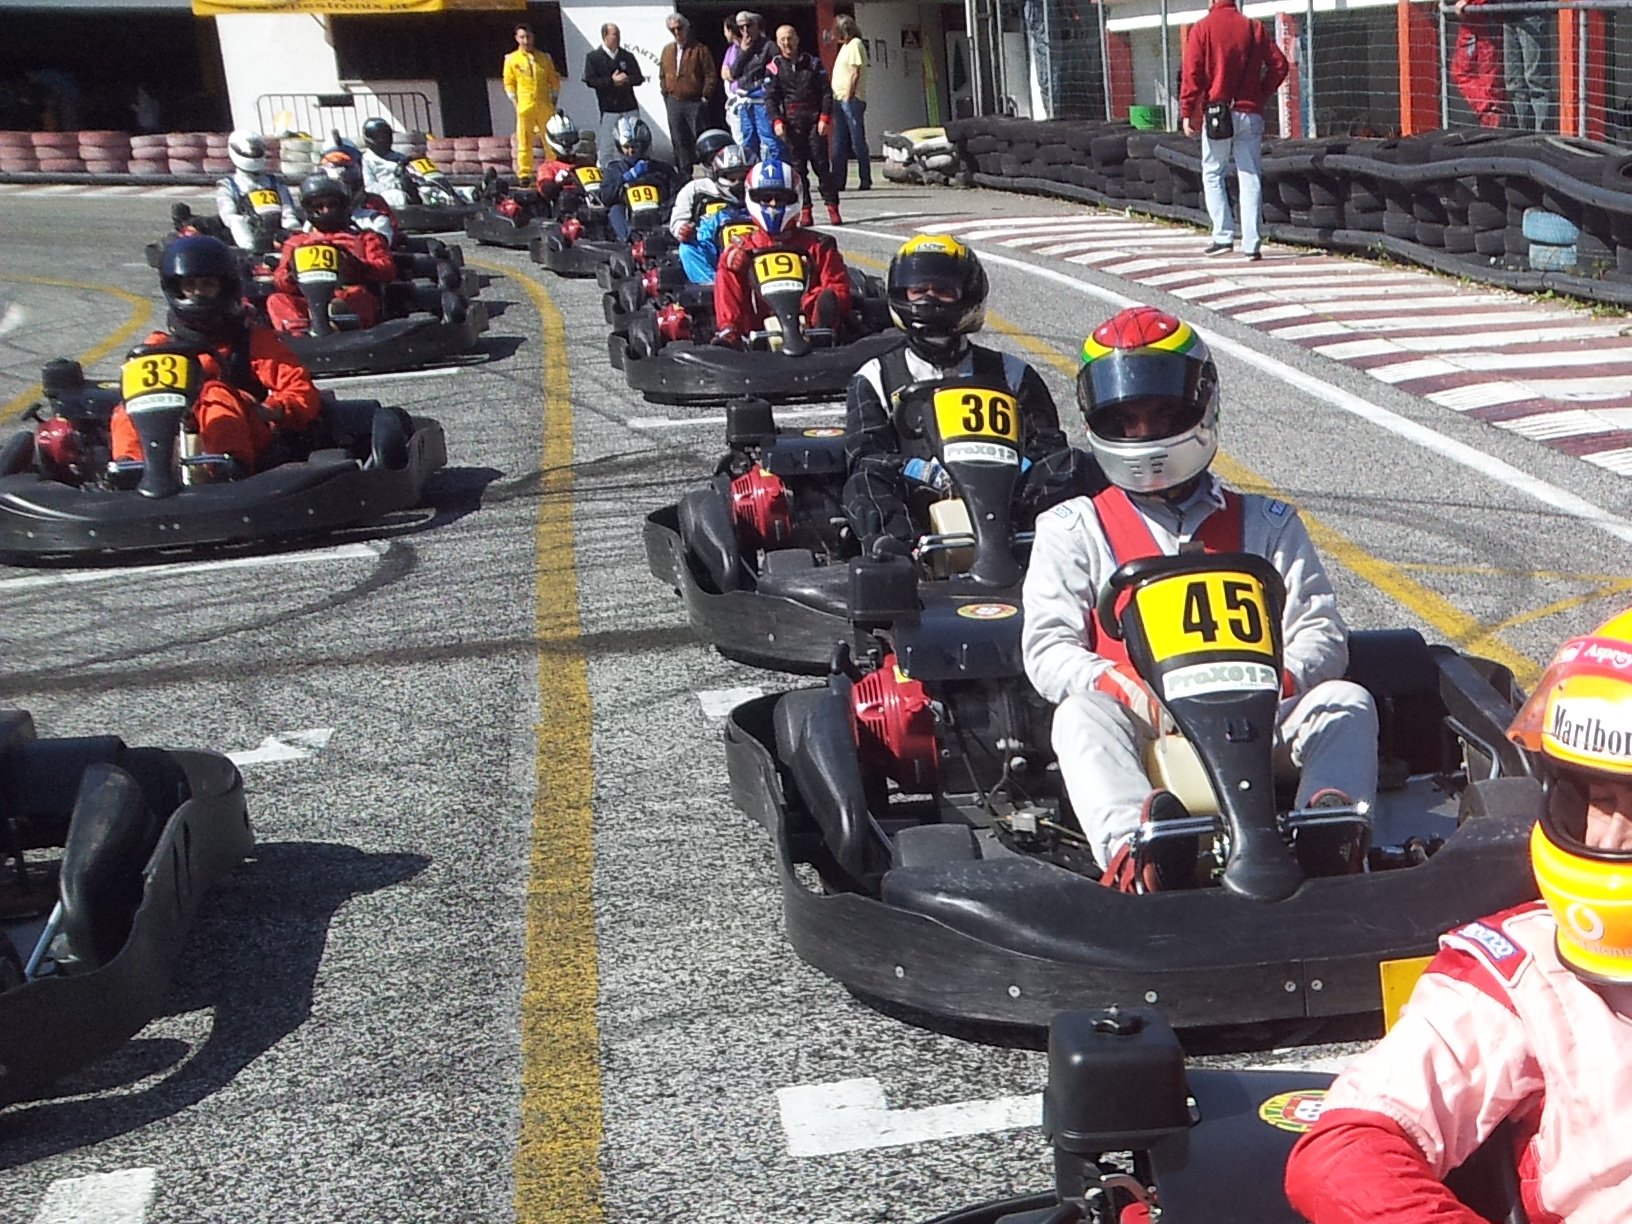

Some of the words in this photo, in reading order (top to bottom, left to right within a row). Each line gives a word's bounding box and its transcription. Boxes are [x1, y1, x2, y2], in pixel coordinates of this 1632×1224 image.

[631, 187, 653, 203] 99
[309, 246, 335, 268] 29
[758, 254, 794, 277] 19
[141, 356, 179, 388] 33
[961, 393, 1011, 436] 36
[1183, 580, 1264, 644] 45
